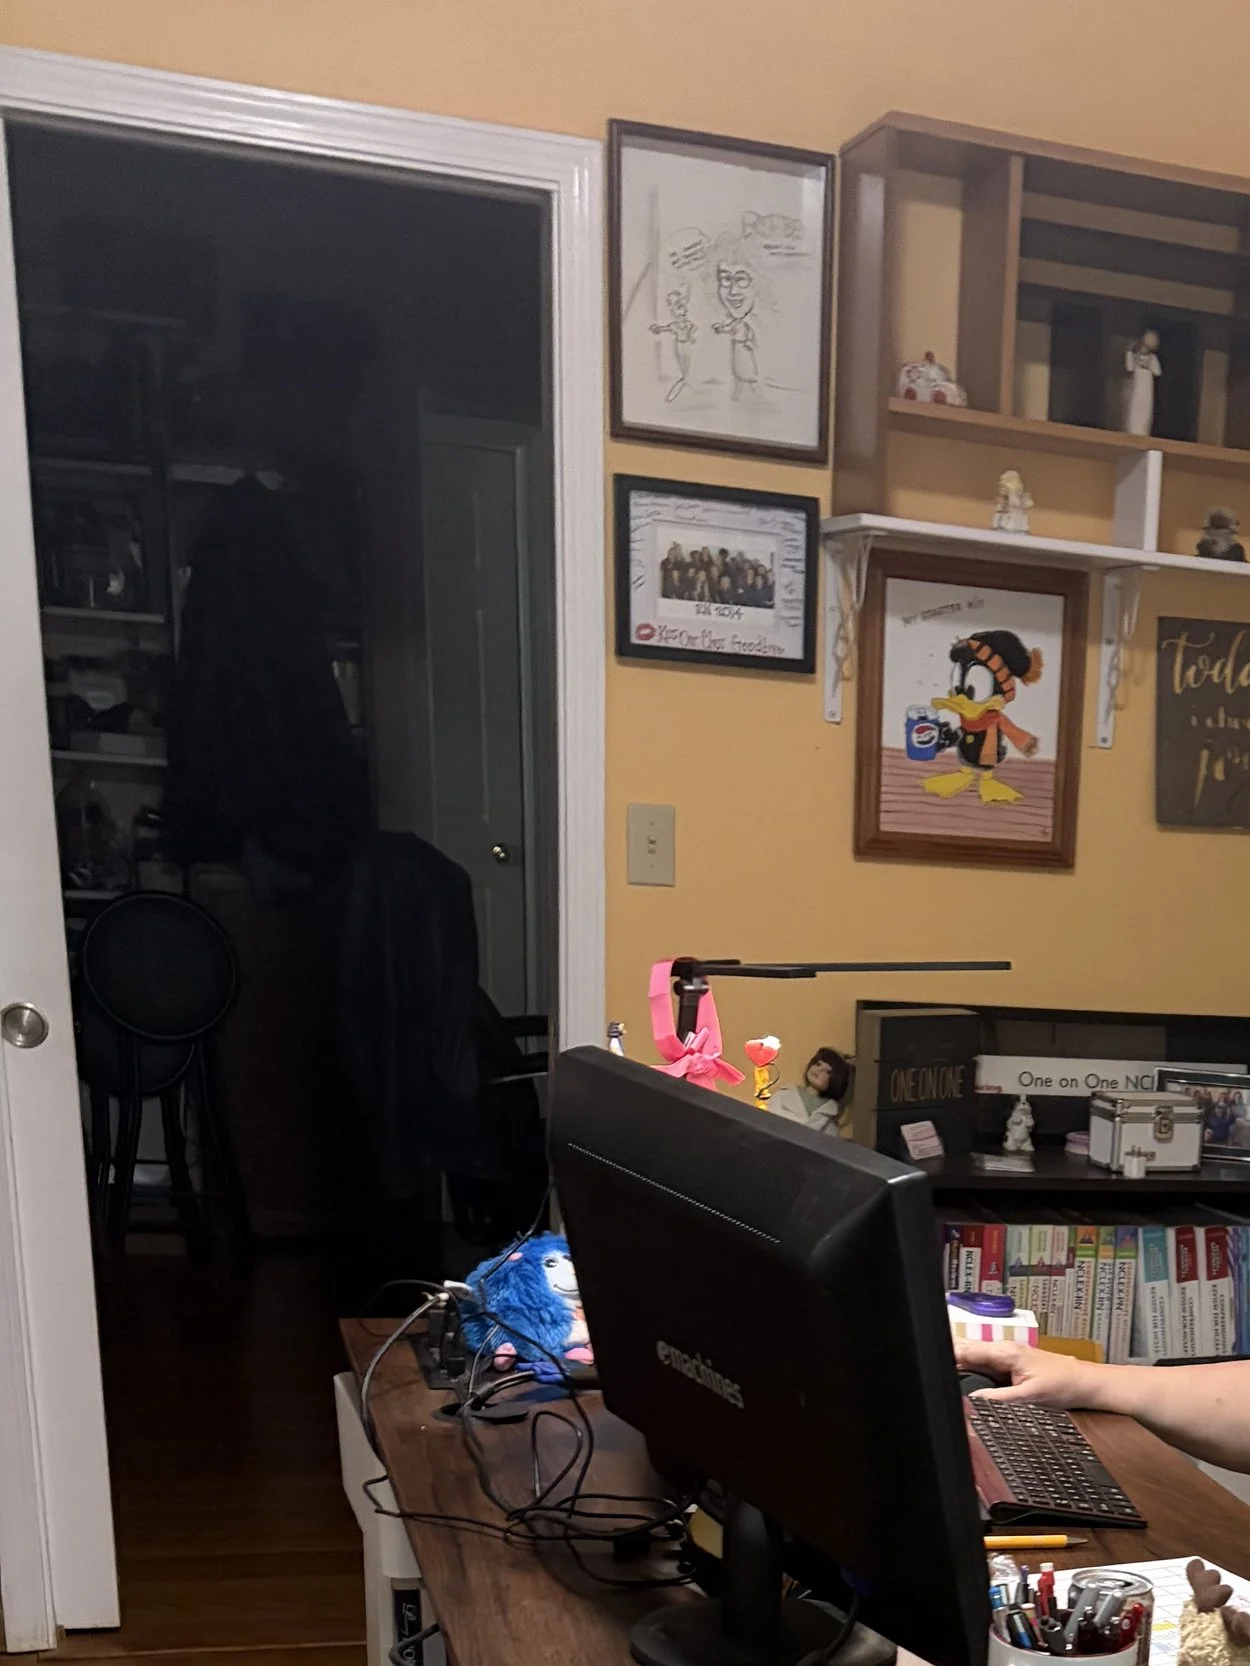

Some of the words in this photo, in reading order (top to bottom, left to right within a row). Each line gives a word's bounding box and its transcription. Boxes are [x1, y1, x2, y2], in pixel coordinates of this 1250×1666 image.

[890, 1067, 916, 1103] ONE
[917, 1067, 938, 1100] ON
[938, 1065, 965, 1100] ONE
[1018, 1070, 1053, 1088] One
[1058, 1076, 1079, 1089] on
[1084, 1073, 1118, 1090] One
[1073, 1260, 1086, 1310] NCLEX-RN
[1096, 1262, 1107, 1311] NCLEX-RN
[1115, 1261, 1128, 1311] NCLEX-PN
[656, 1340, 744, 1409] emachines
